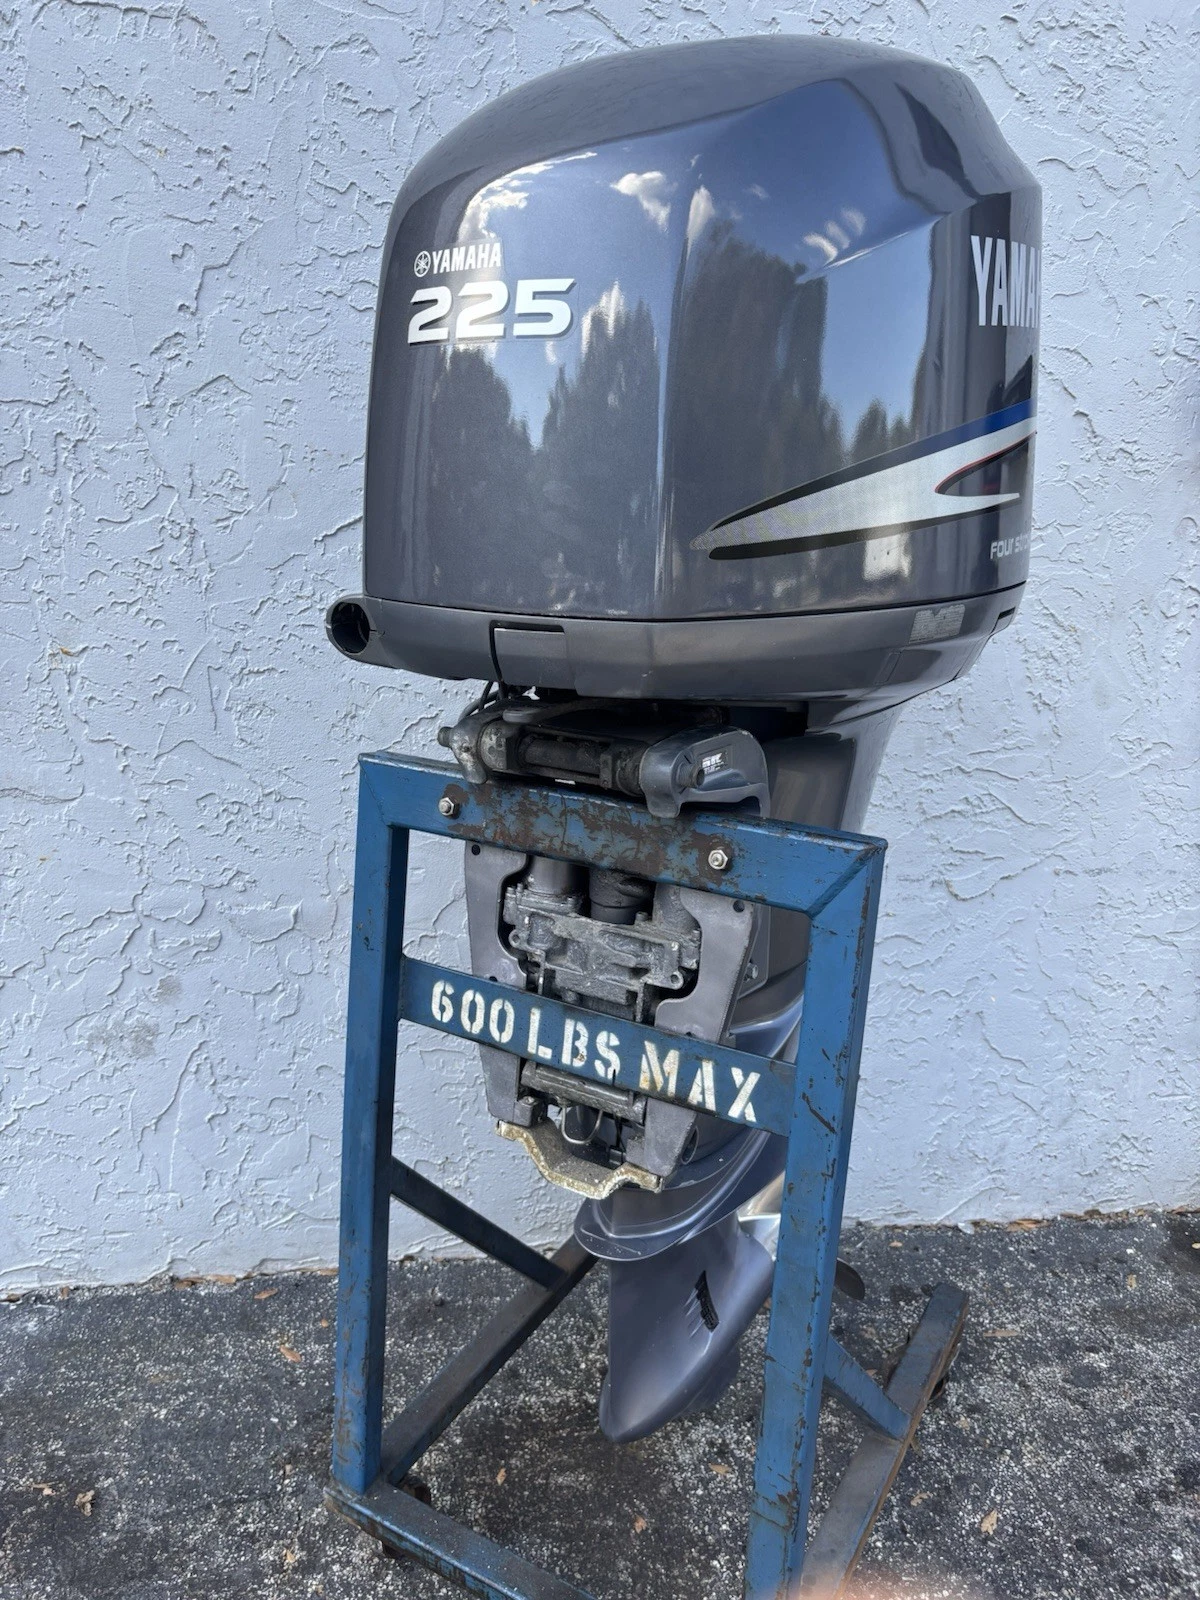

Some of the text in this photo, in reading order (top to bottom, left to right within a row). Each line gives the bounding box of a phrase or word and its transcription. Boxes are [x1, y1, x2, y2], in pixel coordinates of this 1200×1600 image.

[432, 242, 502, 275] YAMAHA
[408, 278, 576, 346] 225
[431, 979, 762, 1123] 600 LBS MAX
